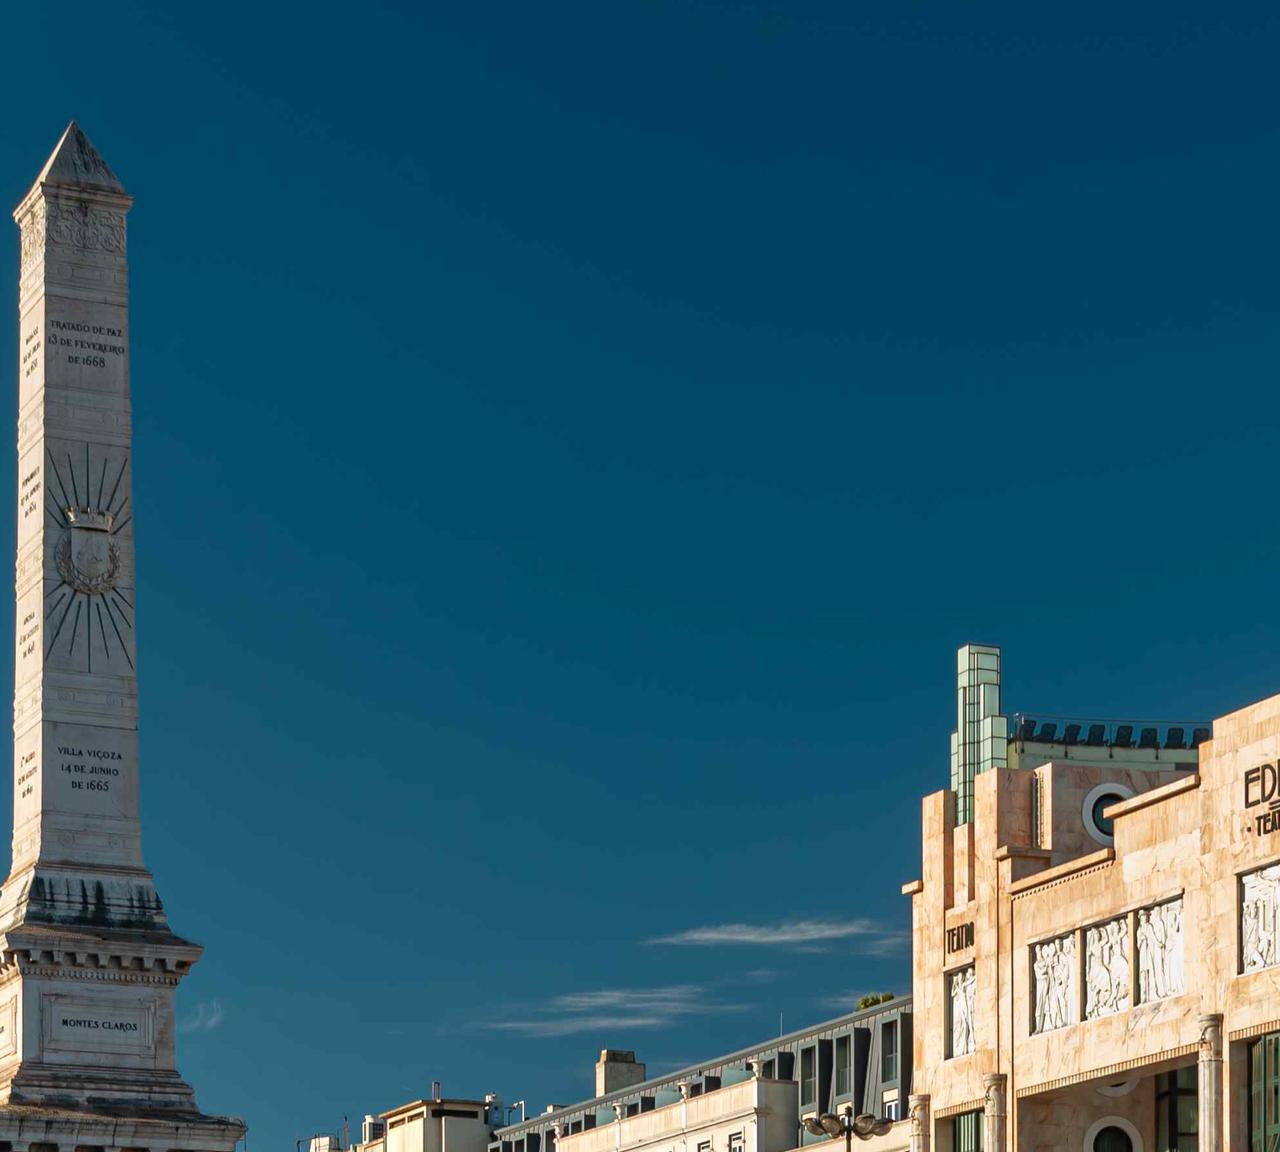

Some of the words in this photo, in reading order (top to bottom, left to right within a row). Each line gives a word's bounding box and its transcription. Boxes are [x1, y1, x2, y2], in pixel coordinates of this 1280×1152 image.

[50, 320, 90, 332] TRATADO
[93, 325, 104, 334] DE
[106, 328, 122, 337] PAZ
[48, 334, 57, 345] 13
[60, 338, 72, 347] DE
[74, 340, 125, 355] FEVEREIRO
[67, 356, 81, 364] DE
[82, 355, 106, 368] 1668
[57, 746, 83, 757] VILLA
[87, 749, 122, 760] VIÇOZA
[61, 764, 71, 774] 14
[74, 765, 87, 774] DE
[89, 766, 119, 776] JUNHO
[71, 781, 84, 789] DE
[86, 780, 110, 791] 1665
[946, 921, 975, 954] TEATRO
[62, 1018, 99, 1029] MONTES
[102, 1021, 138, 1032] CLAROS
